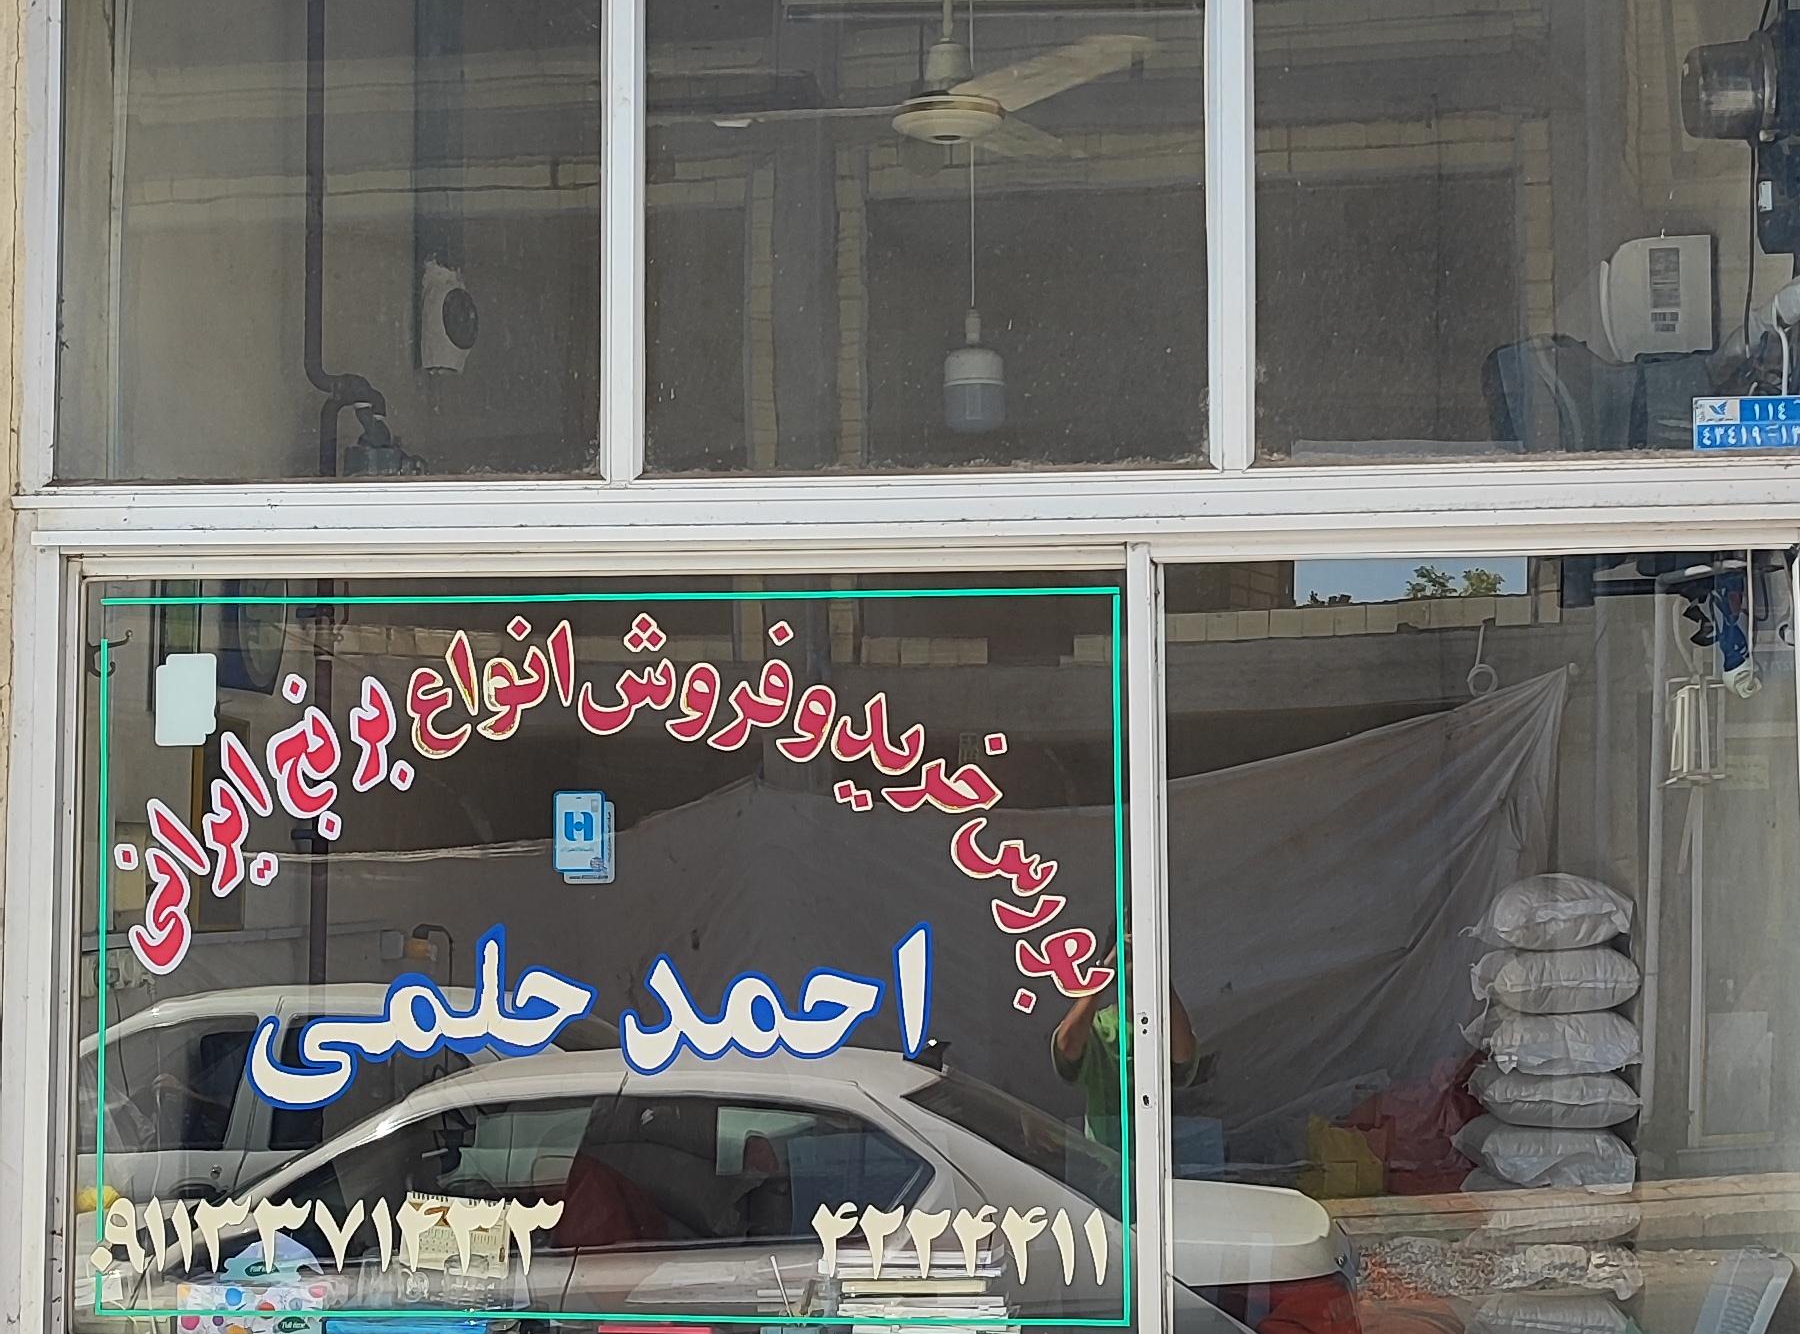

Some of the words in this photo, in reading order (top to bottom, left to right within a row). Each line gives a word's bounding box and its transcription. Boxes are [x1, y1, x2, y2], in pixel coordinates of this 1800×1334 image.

[406, 615, 575, 760] انواع
[577, 612, 795, 752] فروش
[830, 692, 1008, 814] خرید
[266, 673, 415, 841] برنج
[113, 731, 279, 975] ایرانی
[950, 818, 1115, 1014] بورس
[246, 922, 597, 1110] حلمی
[619, 922, 932, 1076] احمد
[90, 1195, 565, 1275] ۰۹۱۱۳۳۷۱۴۳۳
[811, 1202, 1108, 1286] ۴۲۲۴۴۱۱
